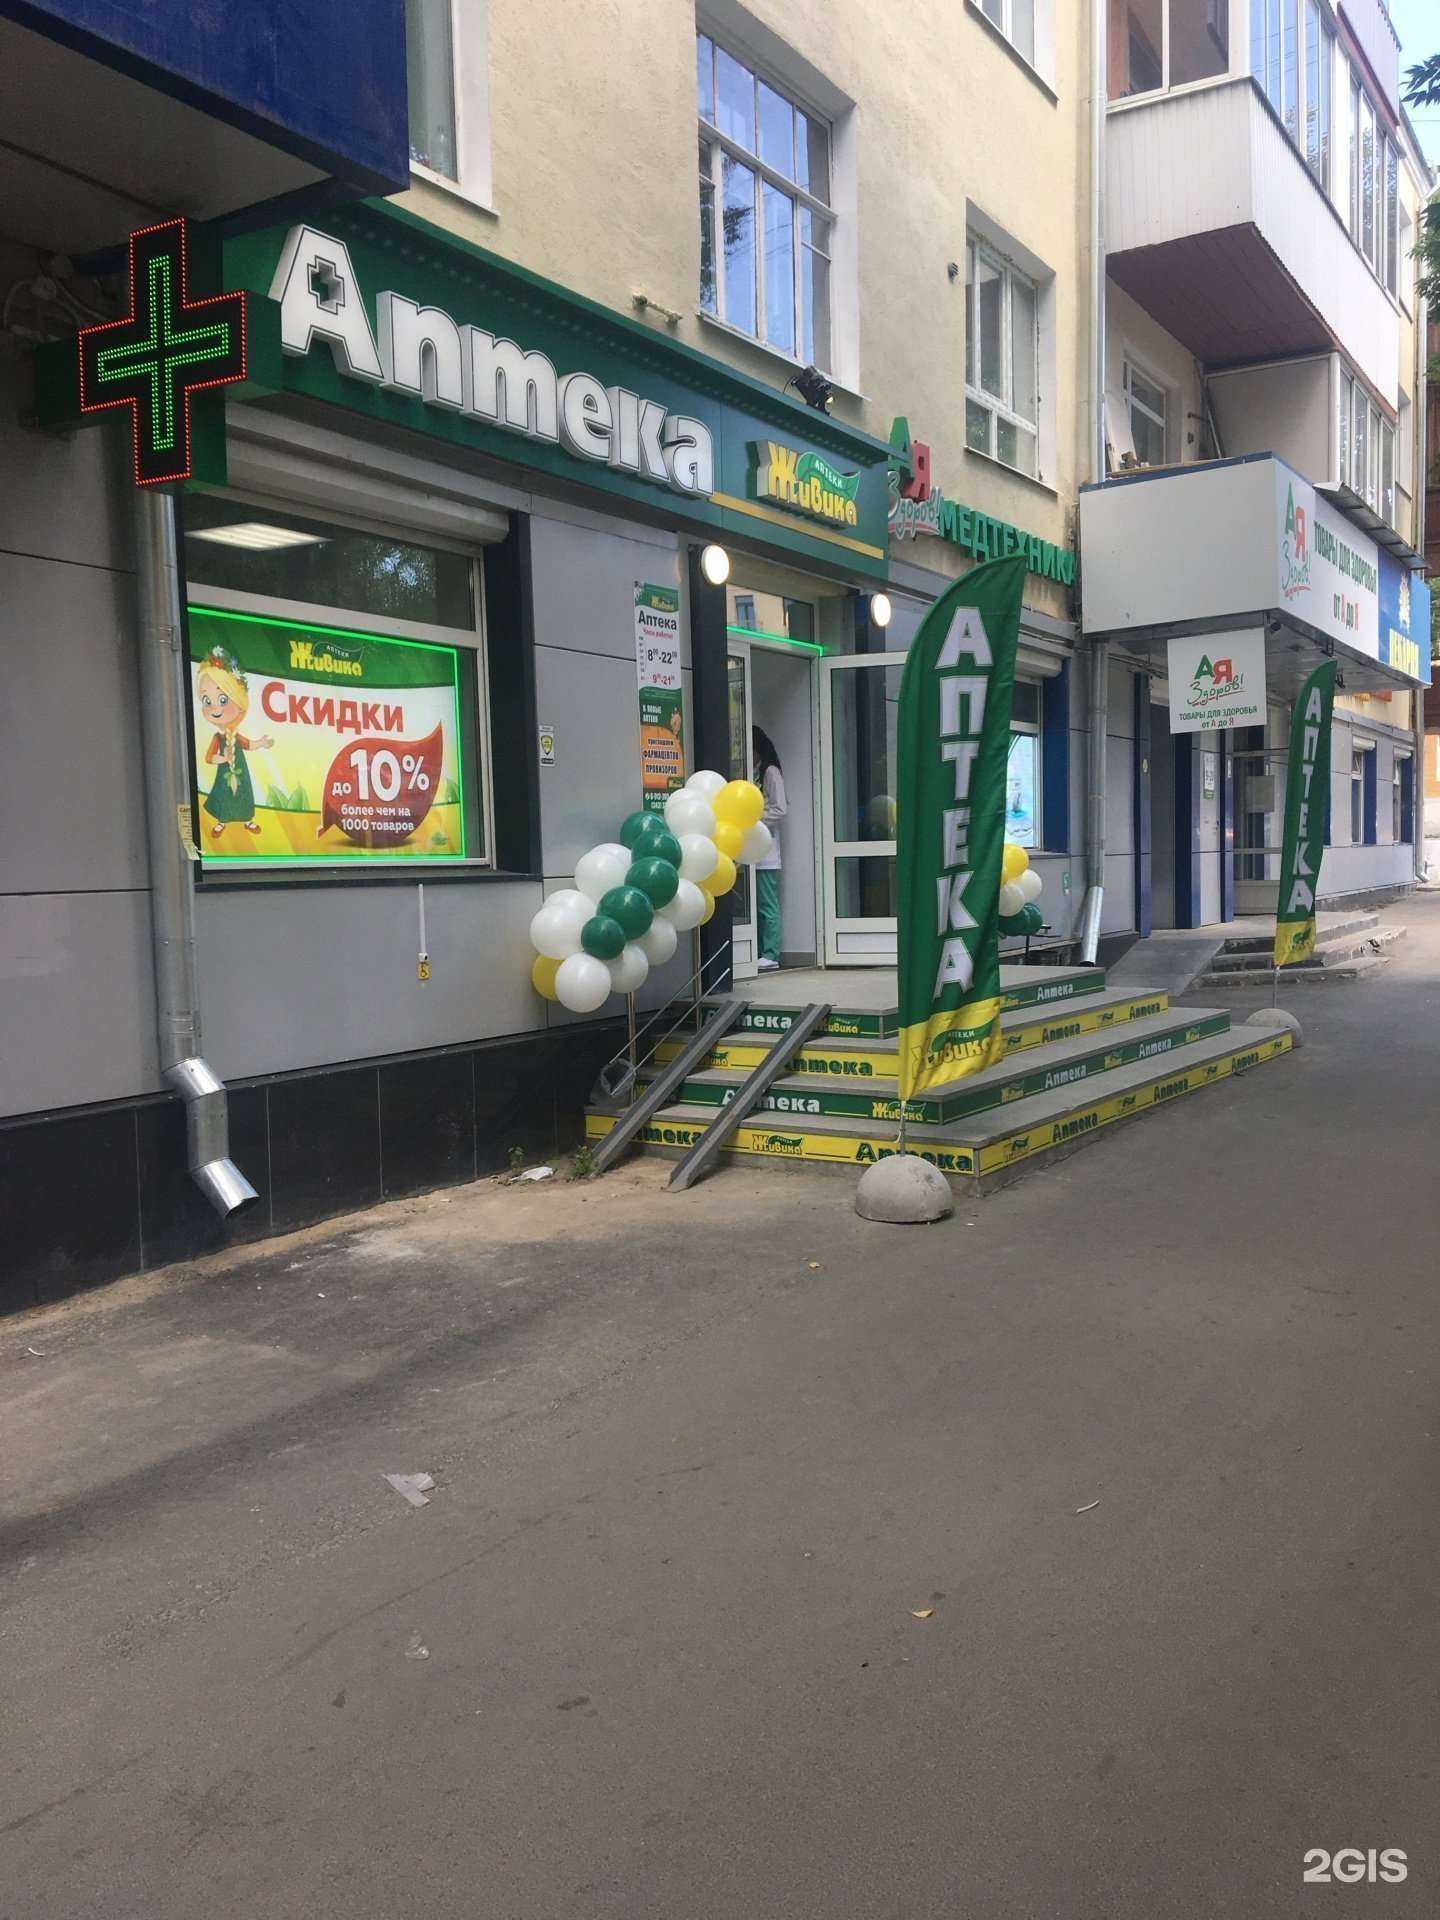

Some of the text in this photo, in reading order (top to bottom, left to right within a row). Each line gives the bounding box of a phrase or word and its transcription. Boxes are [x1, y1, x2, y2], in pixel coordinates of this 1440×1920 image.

[270, 224, 714, 495] Аптека
[765, 441, 857, 527] Живика
[814, 459, 843, 489] АПТЕКИ
[939, 499, 1074, 586] МЕДТЕХНИК
[638, 609, 678, 631] Аптека
[289, 640, 363, 676] Живика
[1187, 672, 1245, 706] Здоров!
[1178, 705, 1258, 721] ТОВАРЫ ДЛЯ ЗДОРОВЬЯ
[1211, 719, 1216, 727] А
[1217, 720, 1227, 729] до
[1228, 717, 1234, 726] Я
[332, 748, 430, 802] до 10%
[341, 803, 411, 817] более чем на
[934, 606, 994, 1000] АПТЕКА
[1287, 686, 1322, 914] АПТЕКА
[341, 818, 415, 834] 1000 товаров
[1037, 983, 1074, 1001] Аптека
[1138, 1037, 1172, 1059] Аптека
[1045, 1064, 1088, 1089] Аптека
[1052, 1113, 1099, 1143] Аптека
[751, 1134, 803, 1156] Живика
